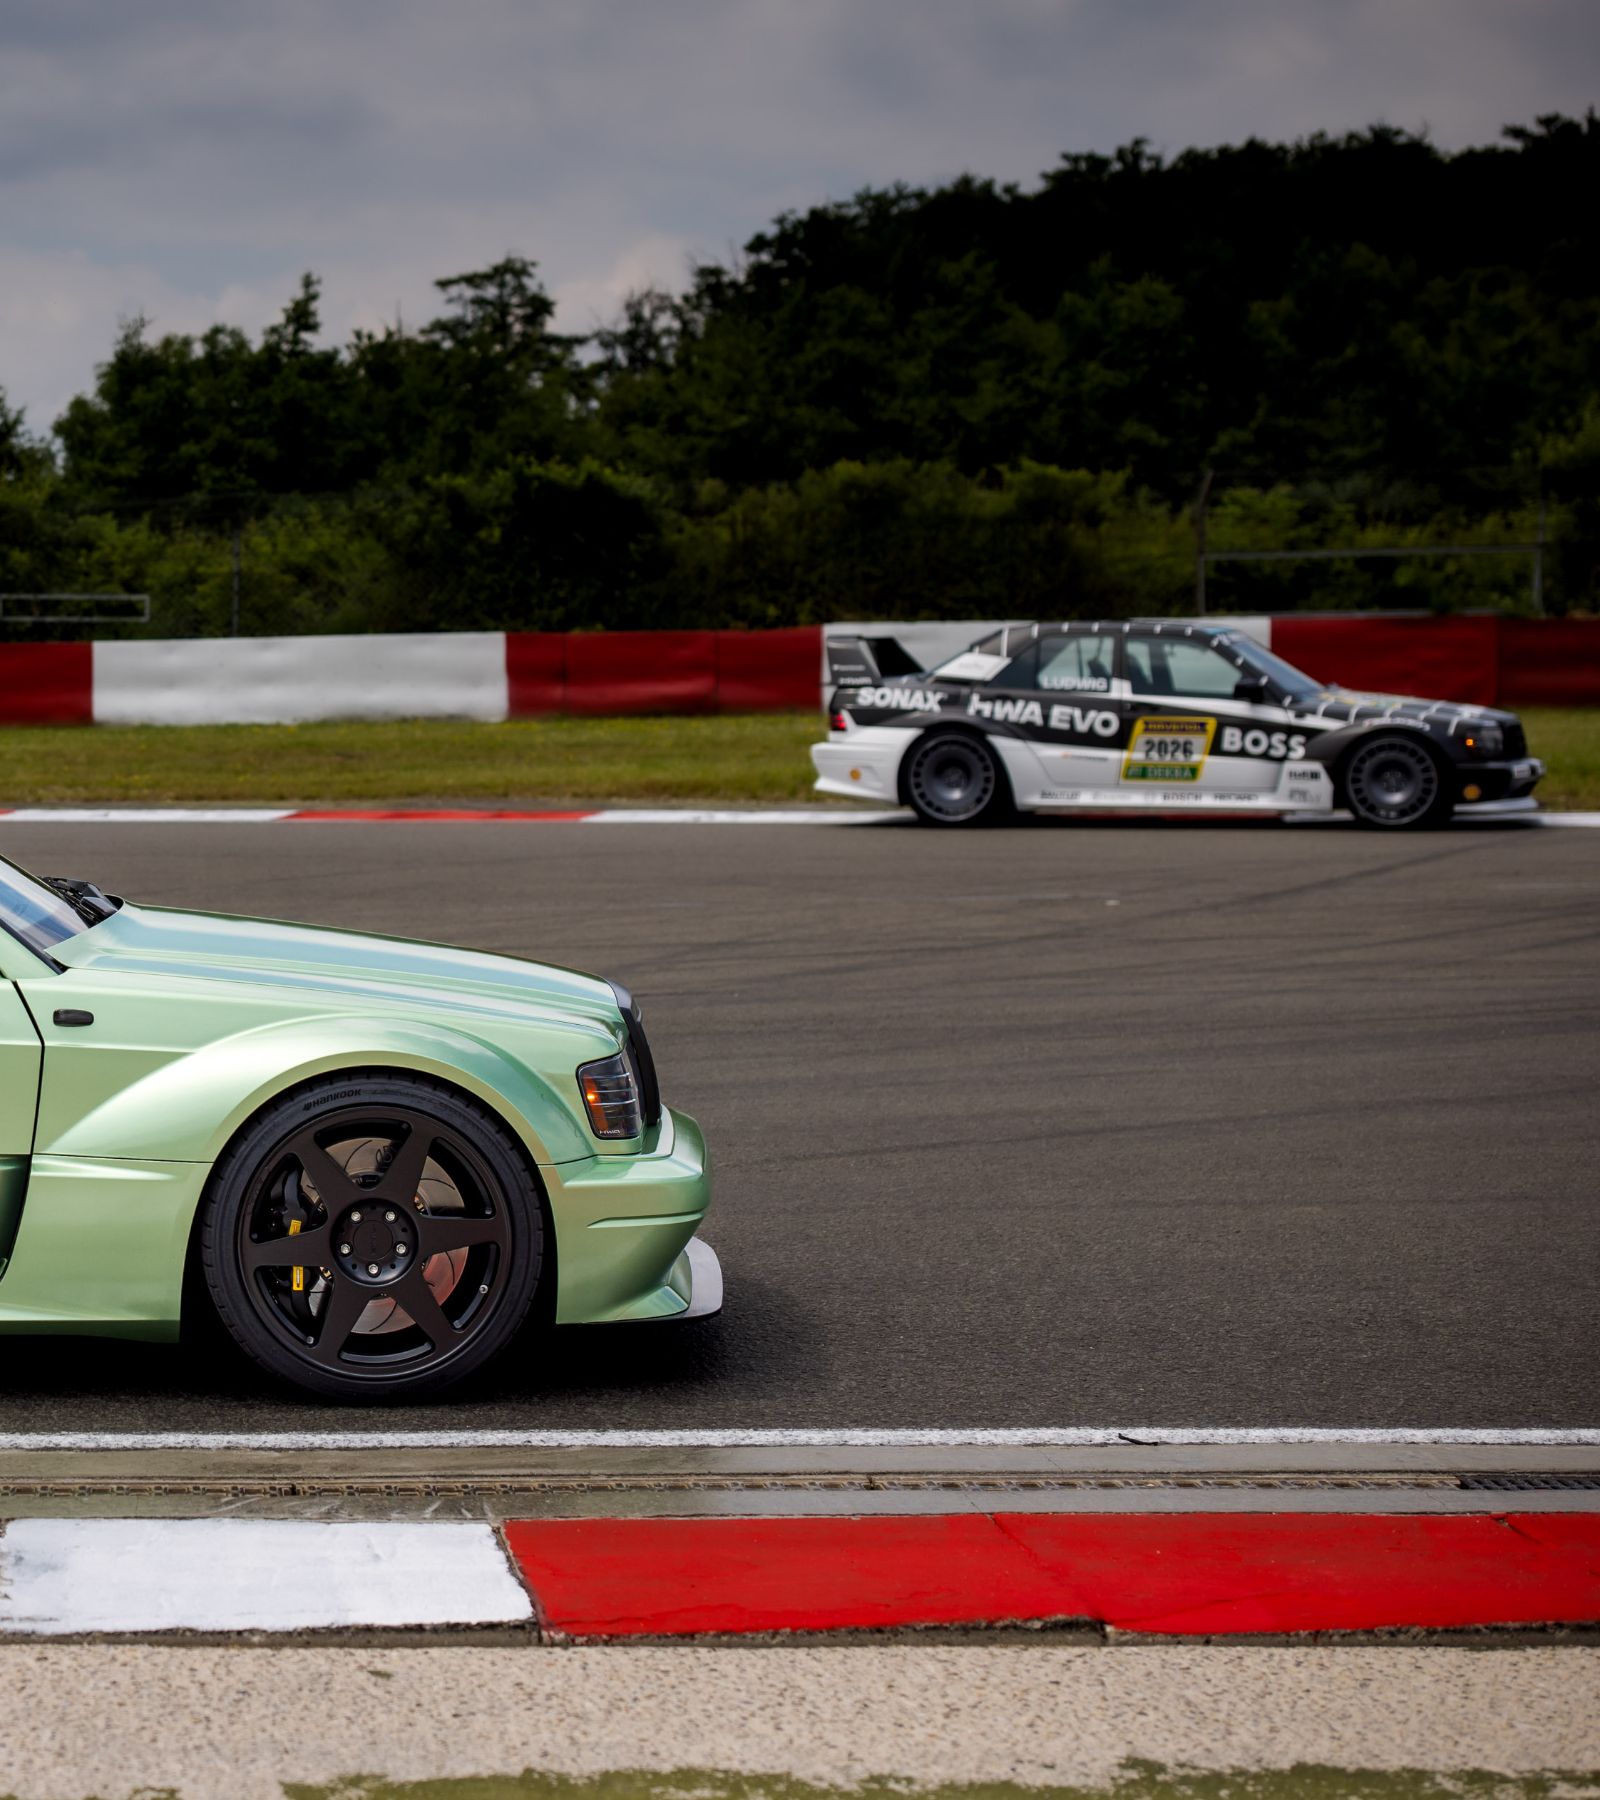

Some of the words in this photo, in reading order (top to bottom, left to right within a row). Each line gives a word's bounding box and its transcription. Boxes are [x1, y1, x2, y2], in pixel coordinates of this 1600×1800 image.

[1043, 676, 1108, 691] LUDWIG
[856, 687, 942, 712] SONAX
[966, 692, 1043, 726] HWA
[1049, 704, 1120, 737] EVO
[1144, 739, 1194, 760] 2026
[1221, 726, 1306, 760] BOSS
